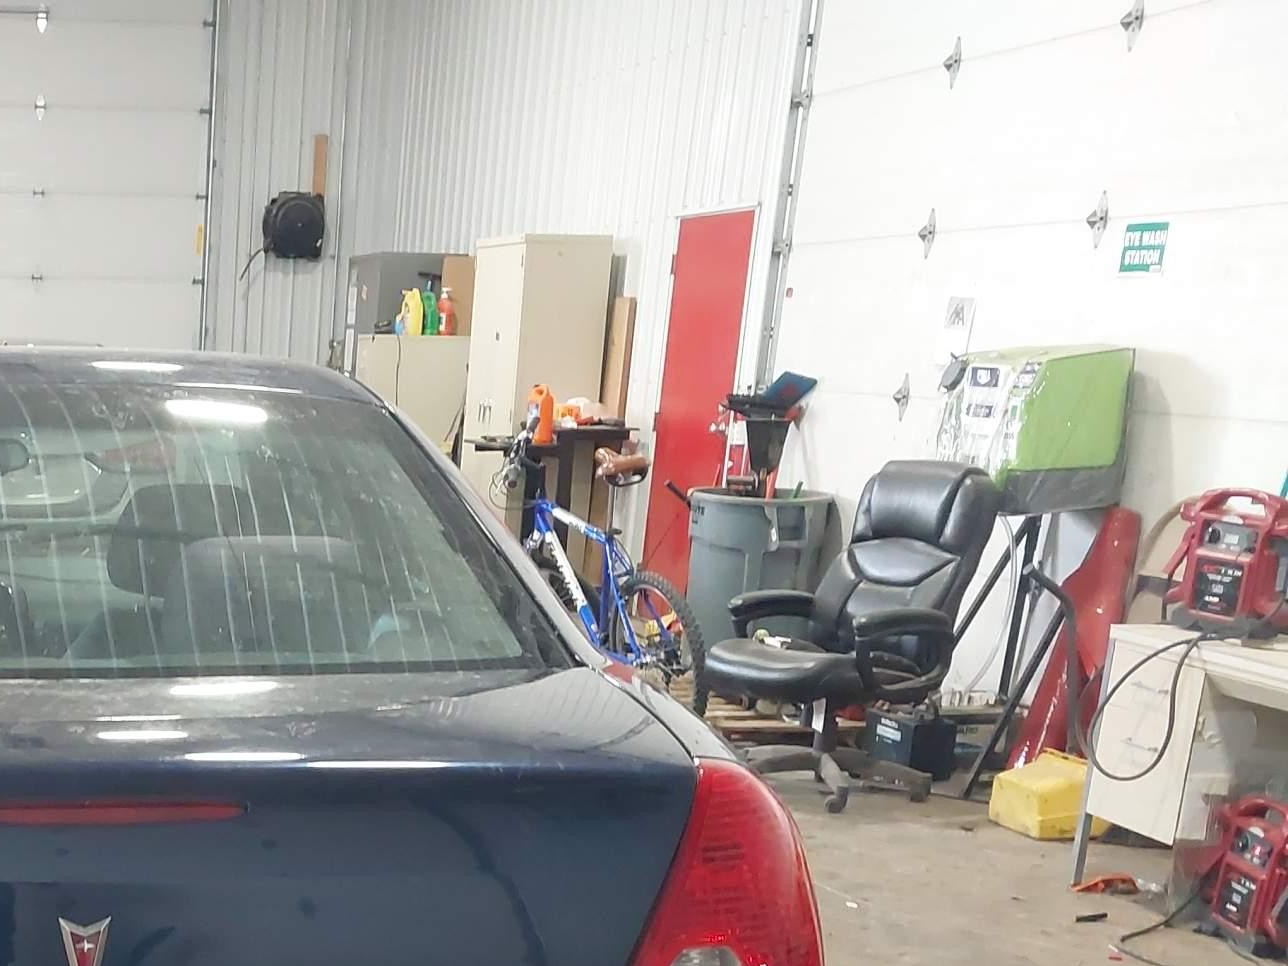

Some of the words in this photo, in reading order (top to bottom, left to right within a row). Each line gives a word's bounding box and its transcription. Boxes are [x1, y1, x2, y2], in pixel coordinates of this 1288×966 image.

[1124, 231, 1142, 247] EYE
[1142, 229, 1168, 246] WASH
[1125, 248, 1162, 266] STATION
